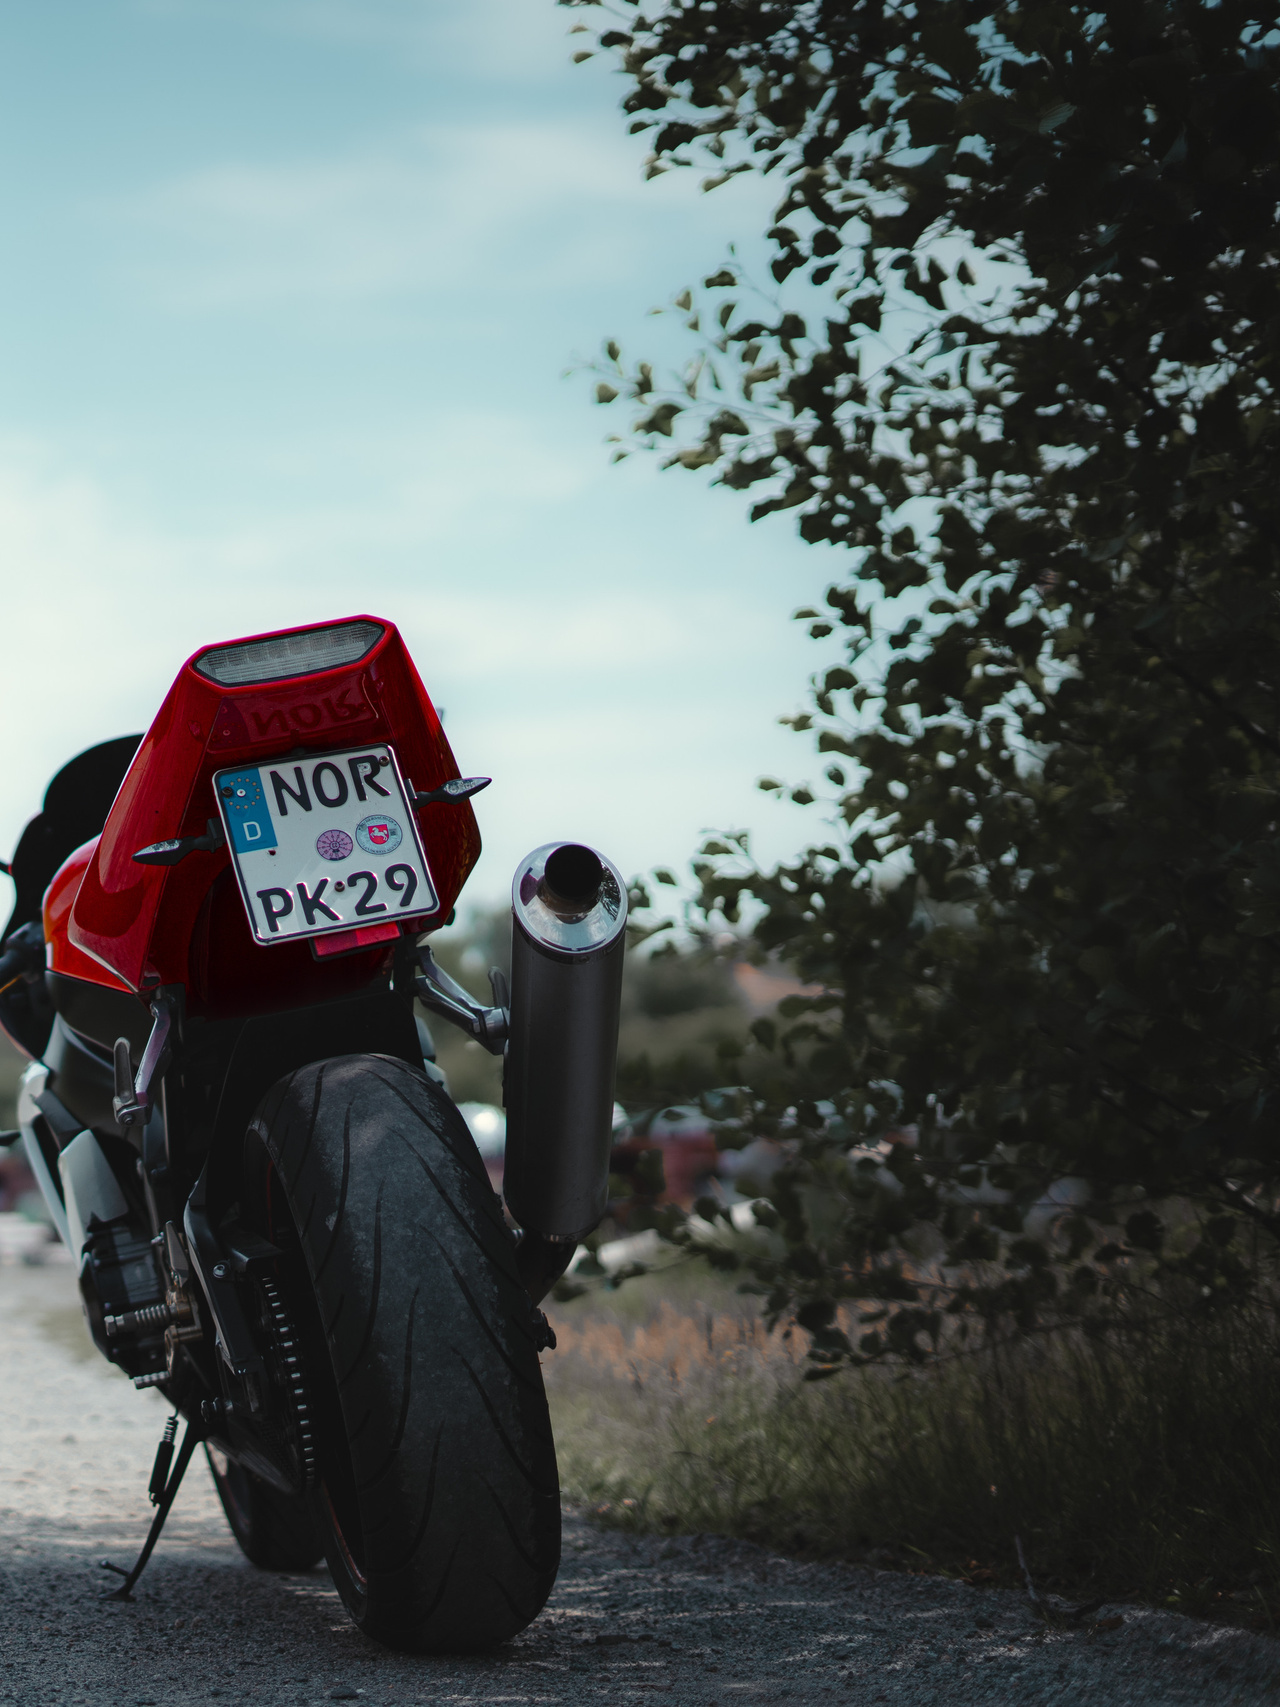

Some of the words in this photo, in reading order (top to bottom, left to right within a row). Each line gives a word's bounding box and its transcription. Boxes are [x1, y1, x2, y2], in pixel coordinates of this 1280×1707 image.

[269, 754, 391, 816] NOR
[242, 821, 261, 841] D
[256, 877, 343, 933] PK
[347, 863, 418, 916] 29
